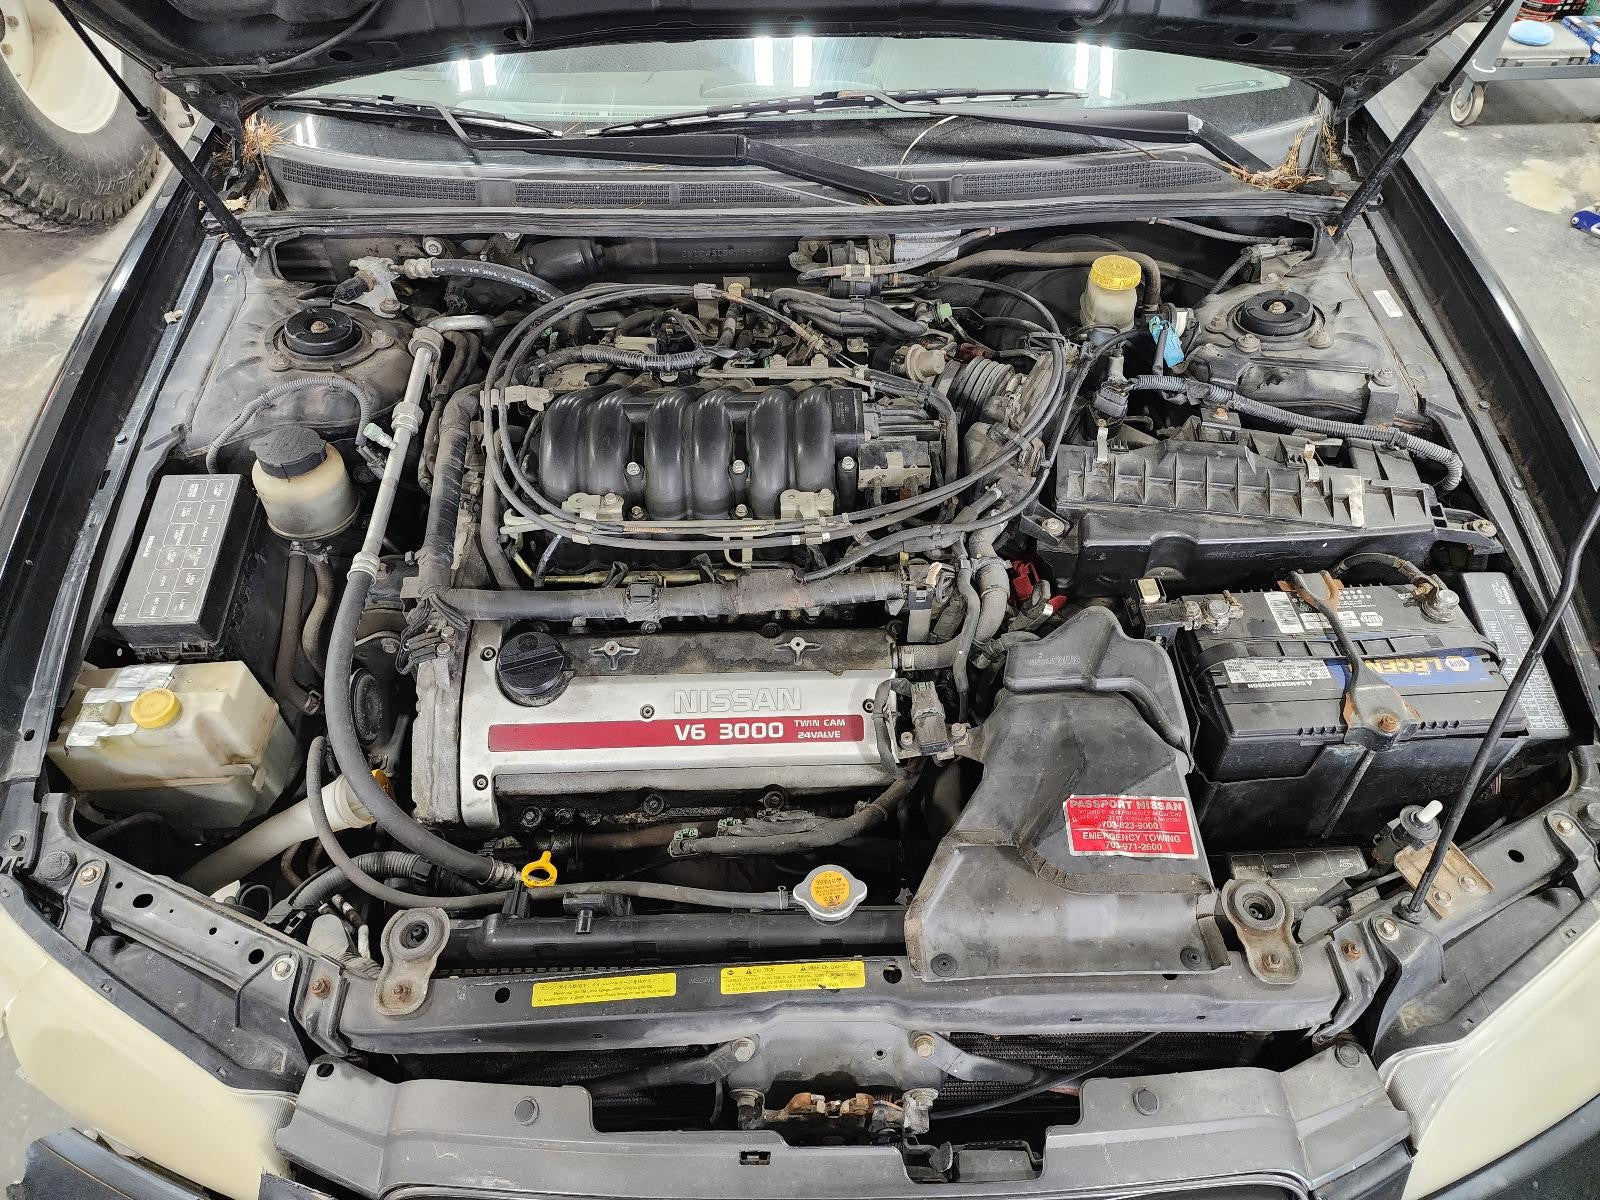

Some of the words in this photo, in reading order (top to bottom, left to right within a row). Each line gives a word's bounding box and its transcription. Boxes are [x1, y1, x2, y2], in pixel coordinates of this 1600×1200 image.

[1363, 657, 1444, 673] LEGEN
[674, 687, 801, 713] NISSAN
[794, 719, 820, 728] TWIN
[823, 718, 846, 727] CAM
[674, 723, 706, 741] V6
[719, 722, 784, 740] 3000
[798, 730, 841, 739] 24VALVE
[1070, 799, 1132, 810] PASSPORT
[1136, 800, 1183, 811] NISSAN
[1101, 820, 1159, 830] 703-823-9000
[1082, 831, 1141, 841] EMERGENCY
[1143, 833, 1181, 843] TOWING
[1105, 841, 1162, 851] 703-971-2600
